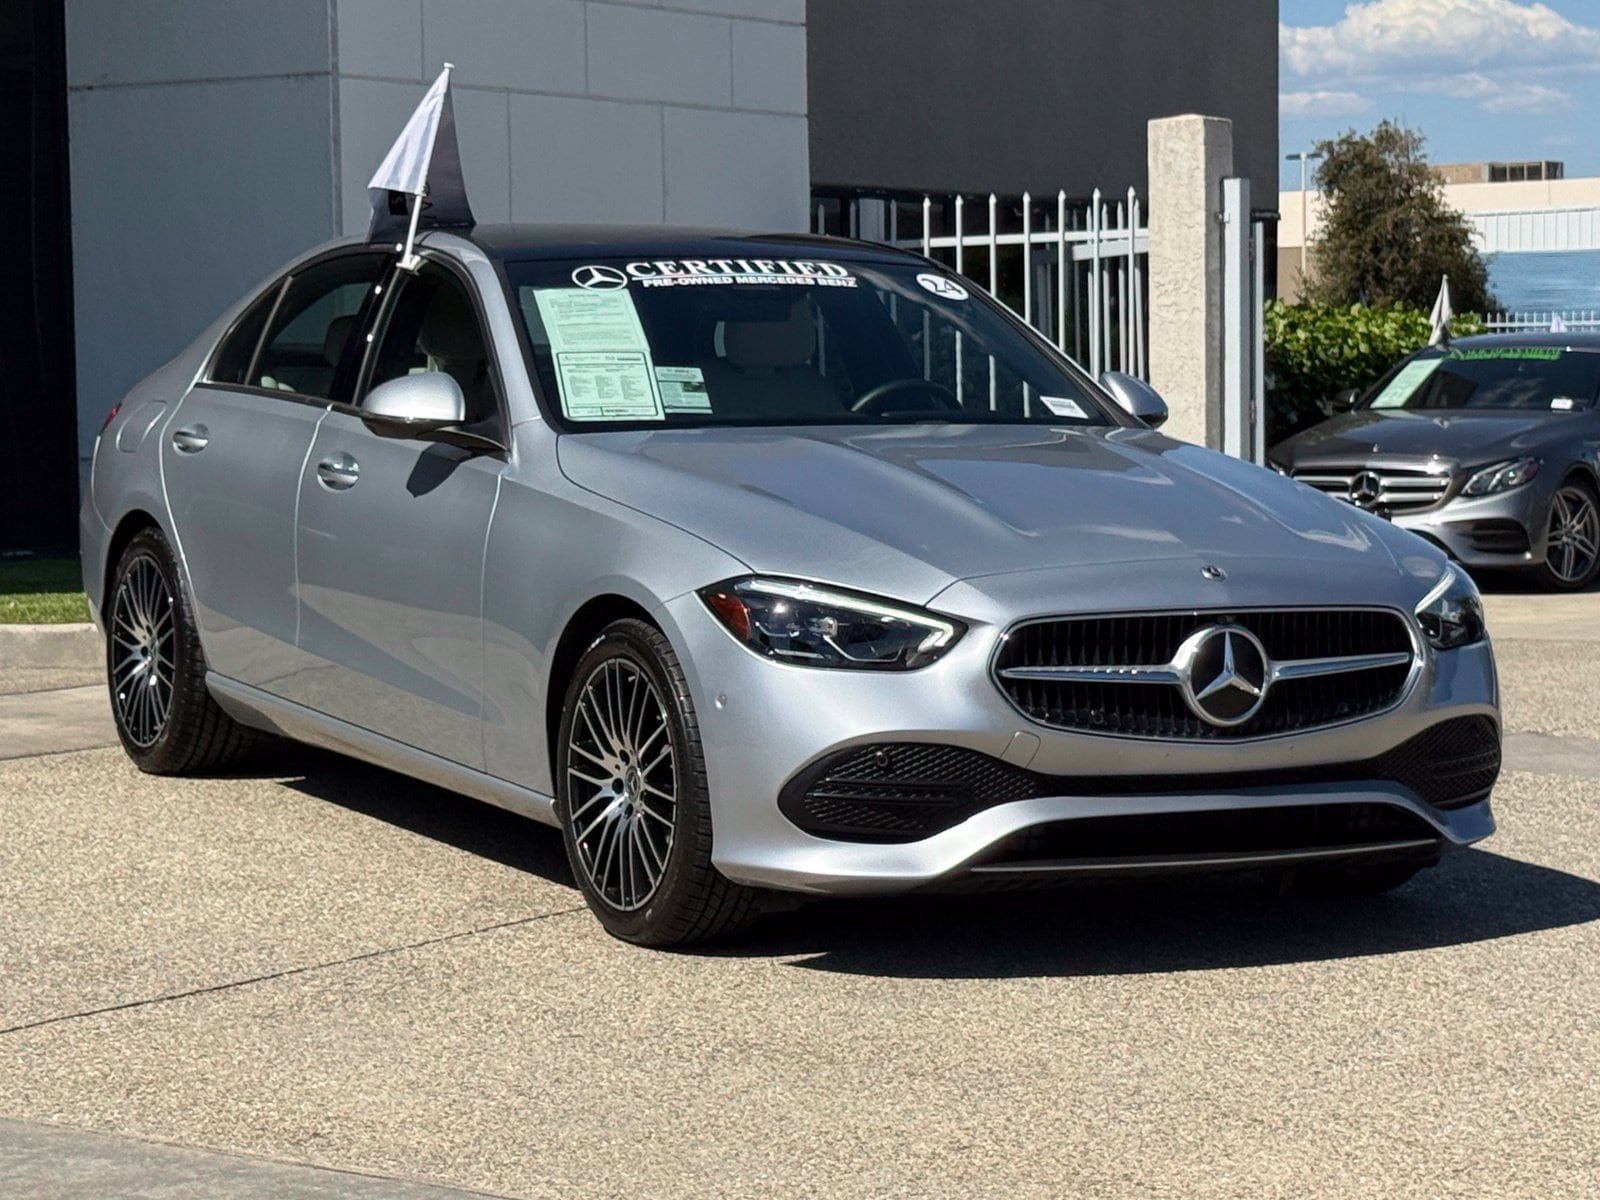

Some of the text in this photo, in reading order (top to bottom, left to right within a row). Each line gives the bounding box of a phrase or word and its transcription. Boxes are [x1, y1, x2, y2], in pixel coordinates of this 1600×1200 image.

[626, 260, 849, 277] CERTIFIED
[643, 276, 858, 288] PRE-OWNED MERCEDES BENZ
[921, 278, 964, 295] 24
